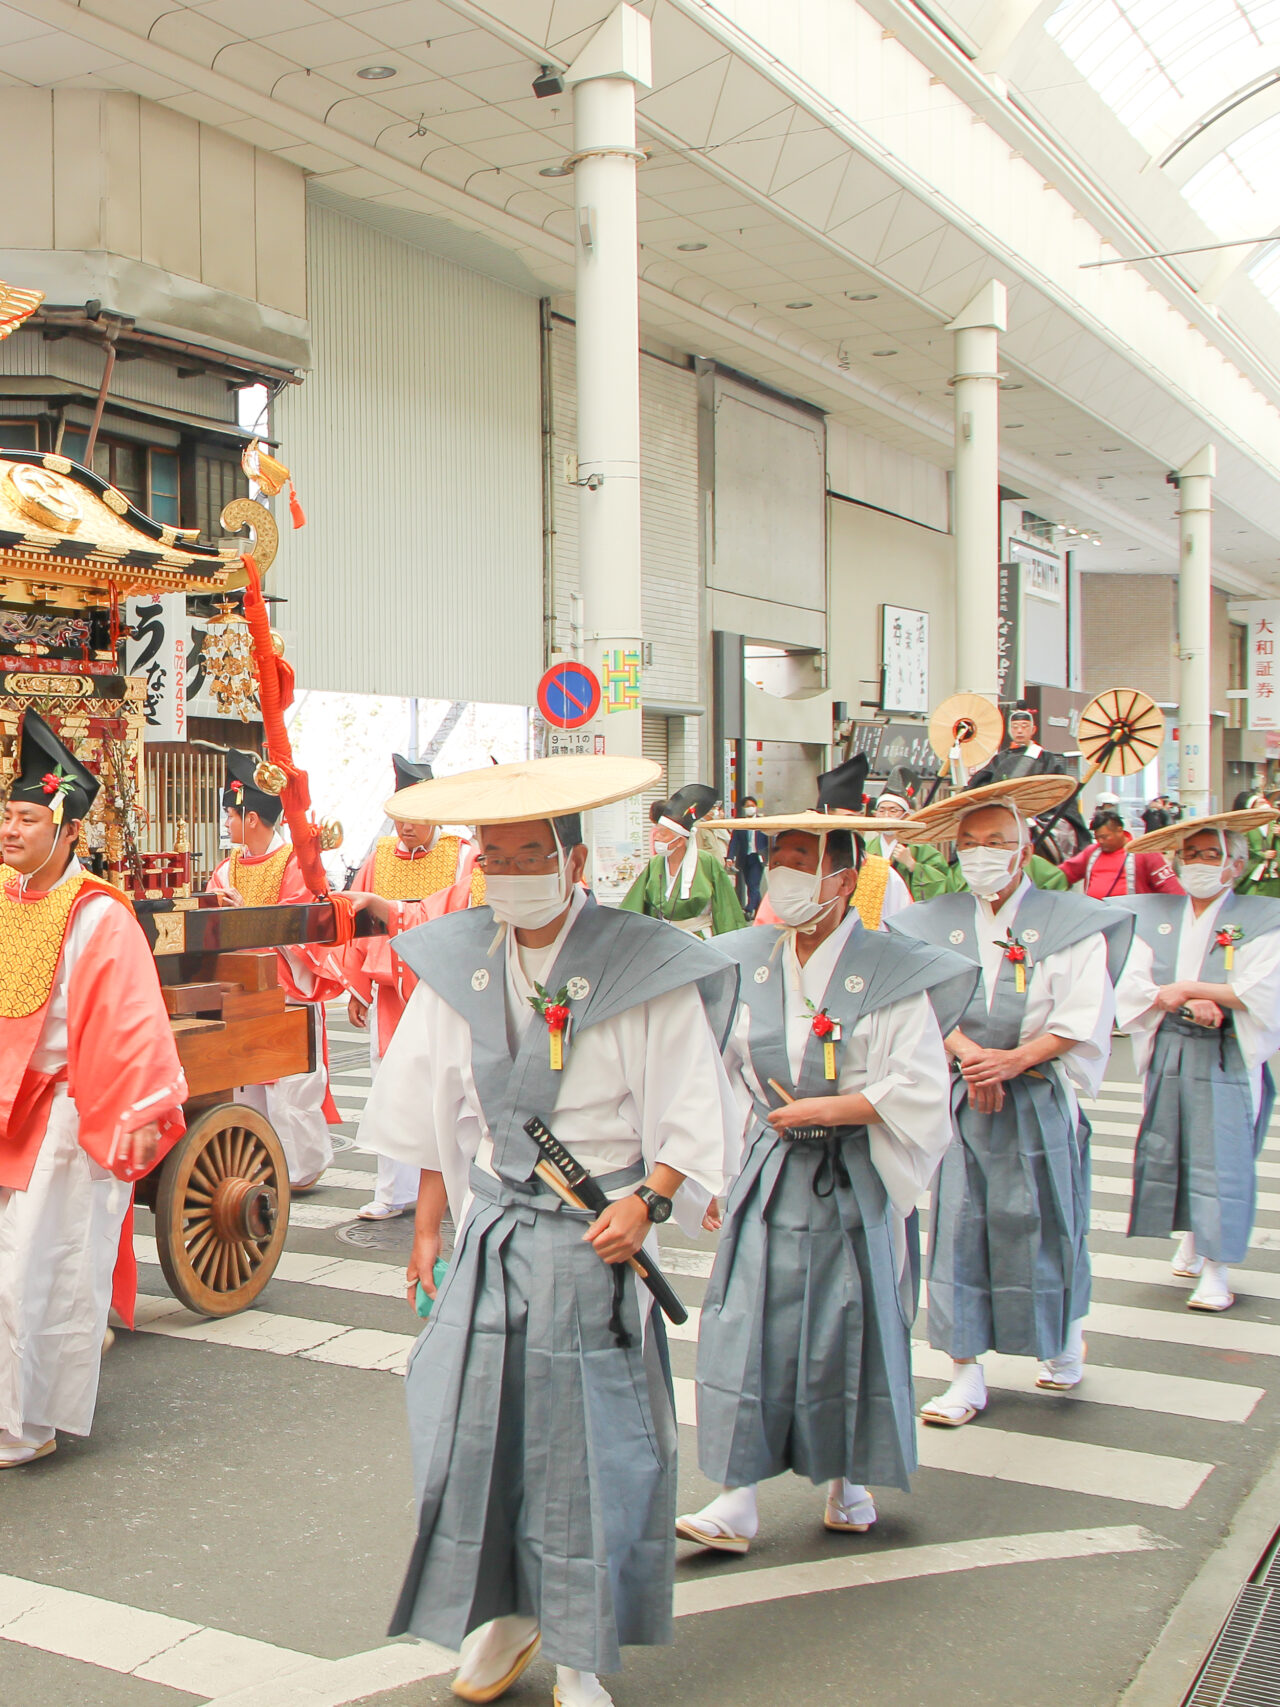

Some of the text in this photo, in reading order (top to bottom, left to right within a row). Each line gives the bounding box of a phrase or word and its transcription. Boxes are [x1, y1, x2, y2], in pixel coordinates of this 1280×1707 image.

[130, 604, 167, 726] うなぎ
[1256, 618, 1274, 698] 大和証券
